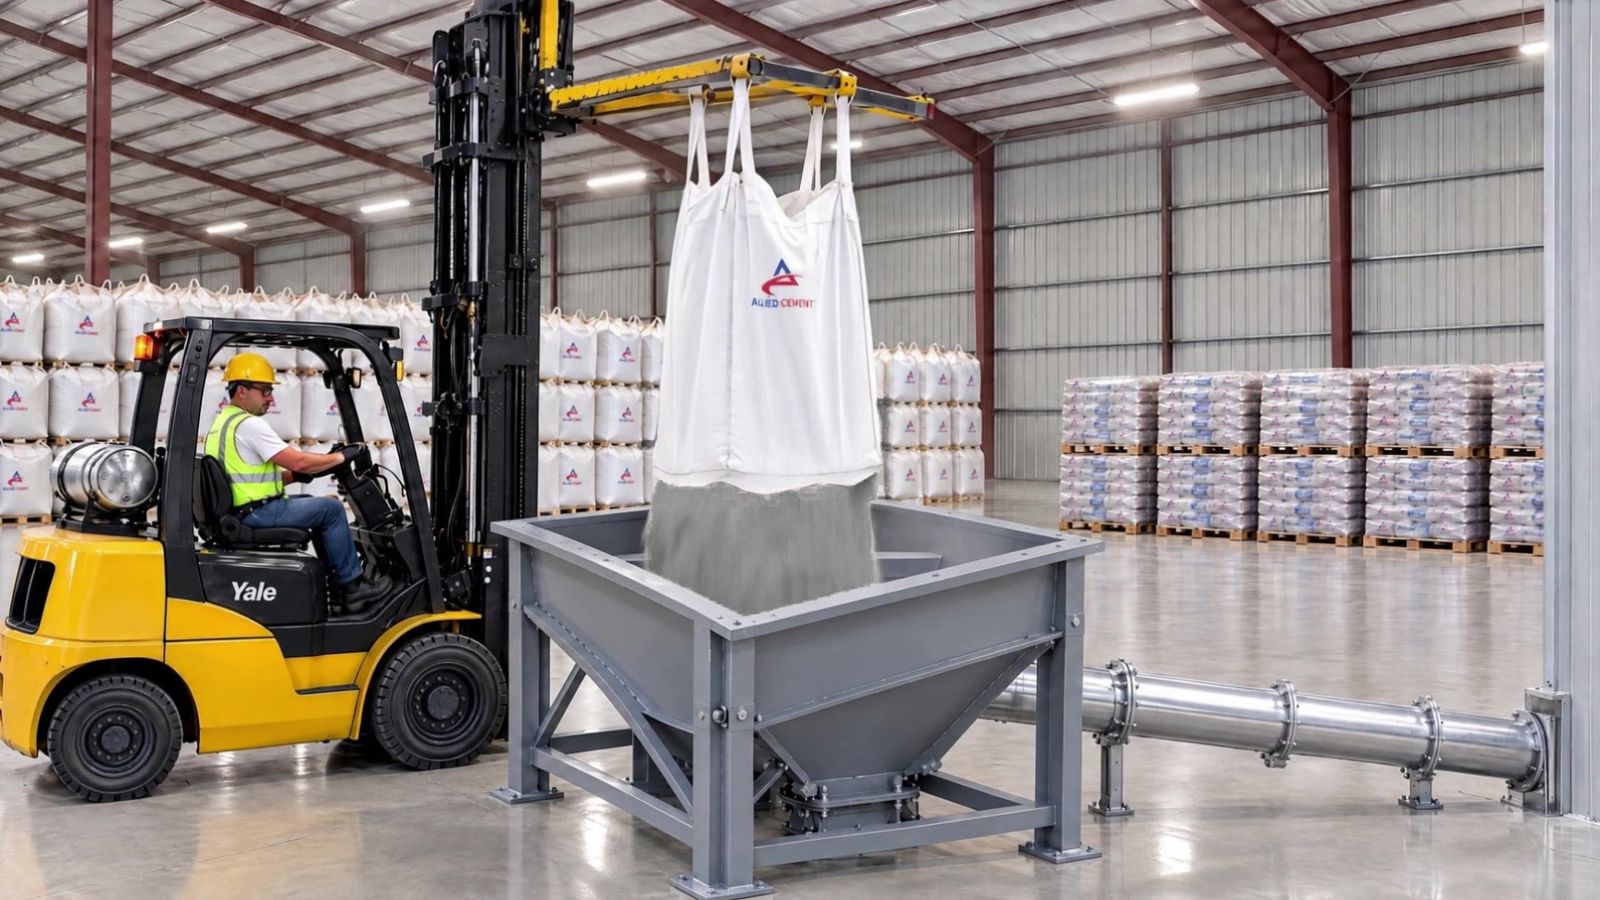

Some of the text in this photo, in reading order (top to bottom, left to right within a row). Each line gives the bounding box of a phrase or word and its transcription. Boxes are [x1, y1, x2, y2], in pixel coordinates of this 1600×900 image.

[752, 297, 814, 309] ALLIED CEMENT
[232, 581, 277, 601] Yale
